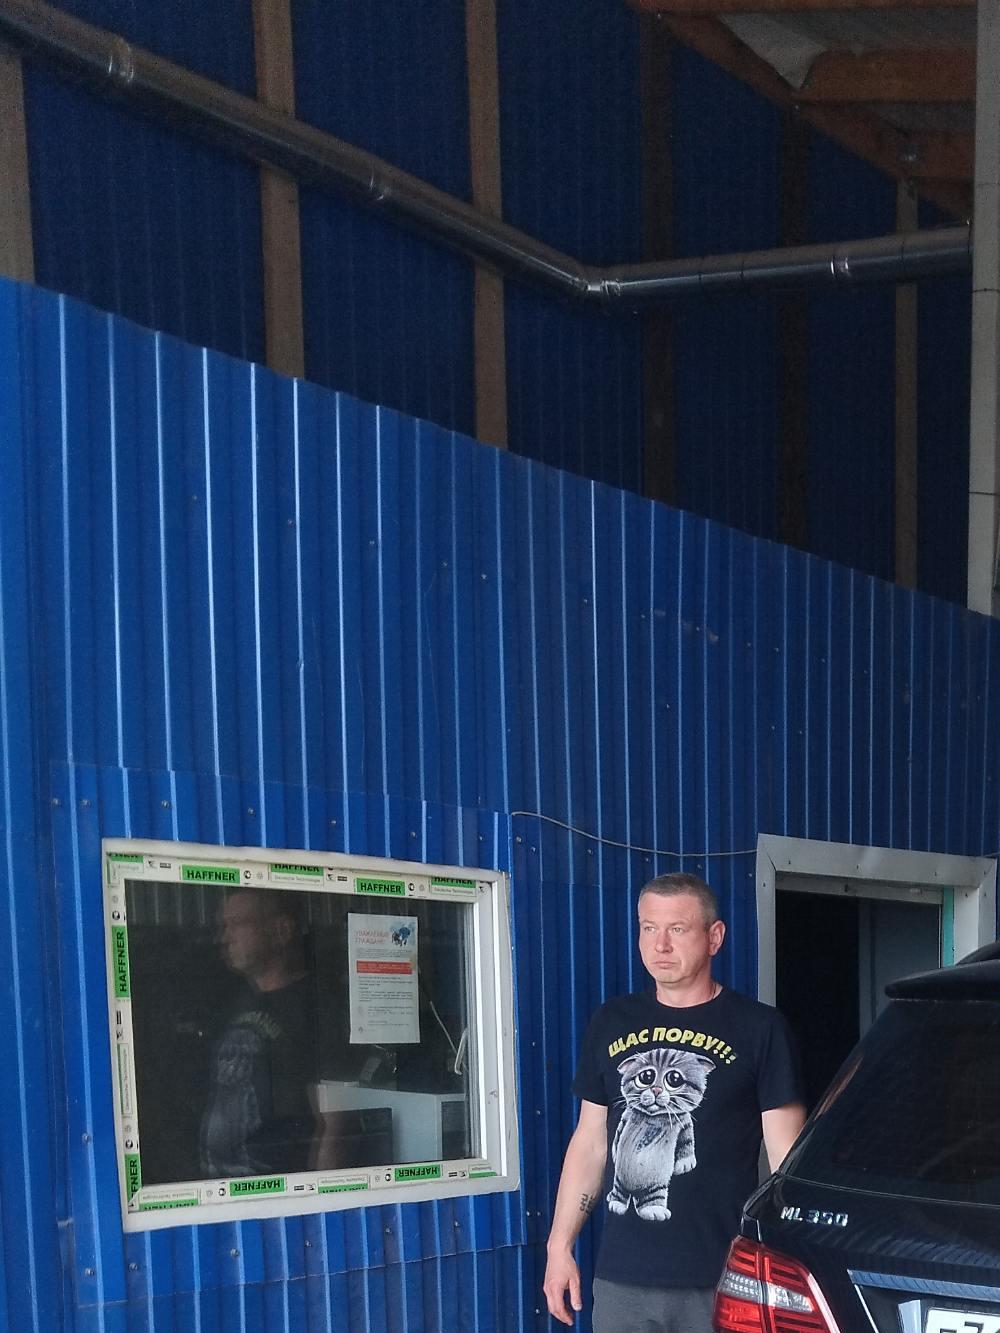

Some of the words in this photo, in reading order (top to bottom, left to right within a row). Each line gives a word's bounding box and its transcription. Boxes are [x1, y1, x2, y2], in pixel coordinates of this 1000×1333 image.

[186, 869, 236, 882] HAFFNER
[360, 882, 402, 894] HAFFNER
[116, 931, 127, 992] HAFFNER
[608, 1028, 649, 1058] ЩАС
[398, 1167, 438, 1178] HAFFNER
[234, 1179, 281, 1192] HAFFNER
[780, 1206, 804, 1222] ML
